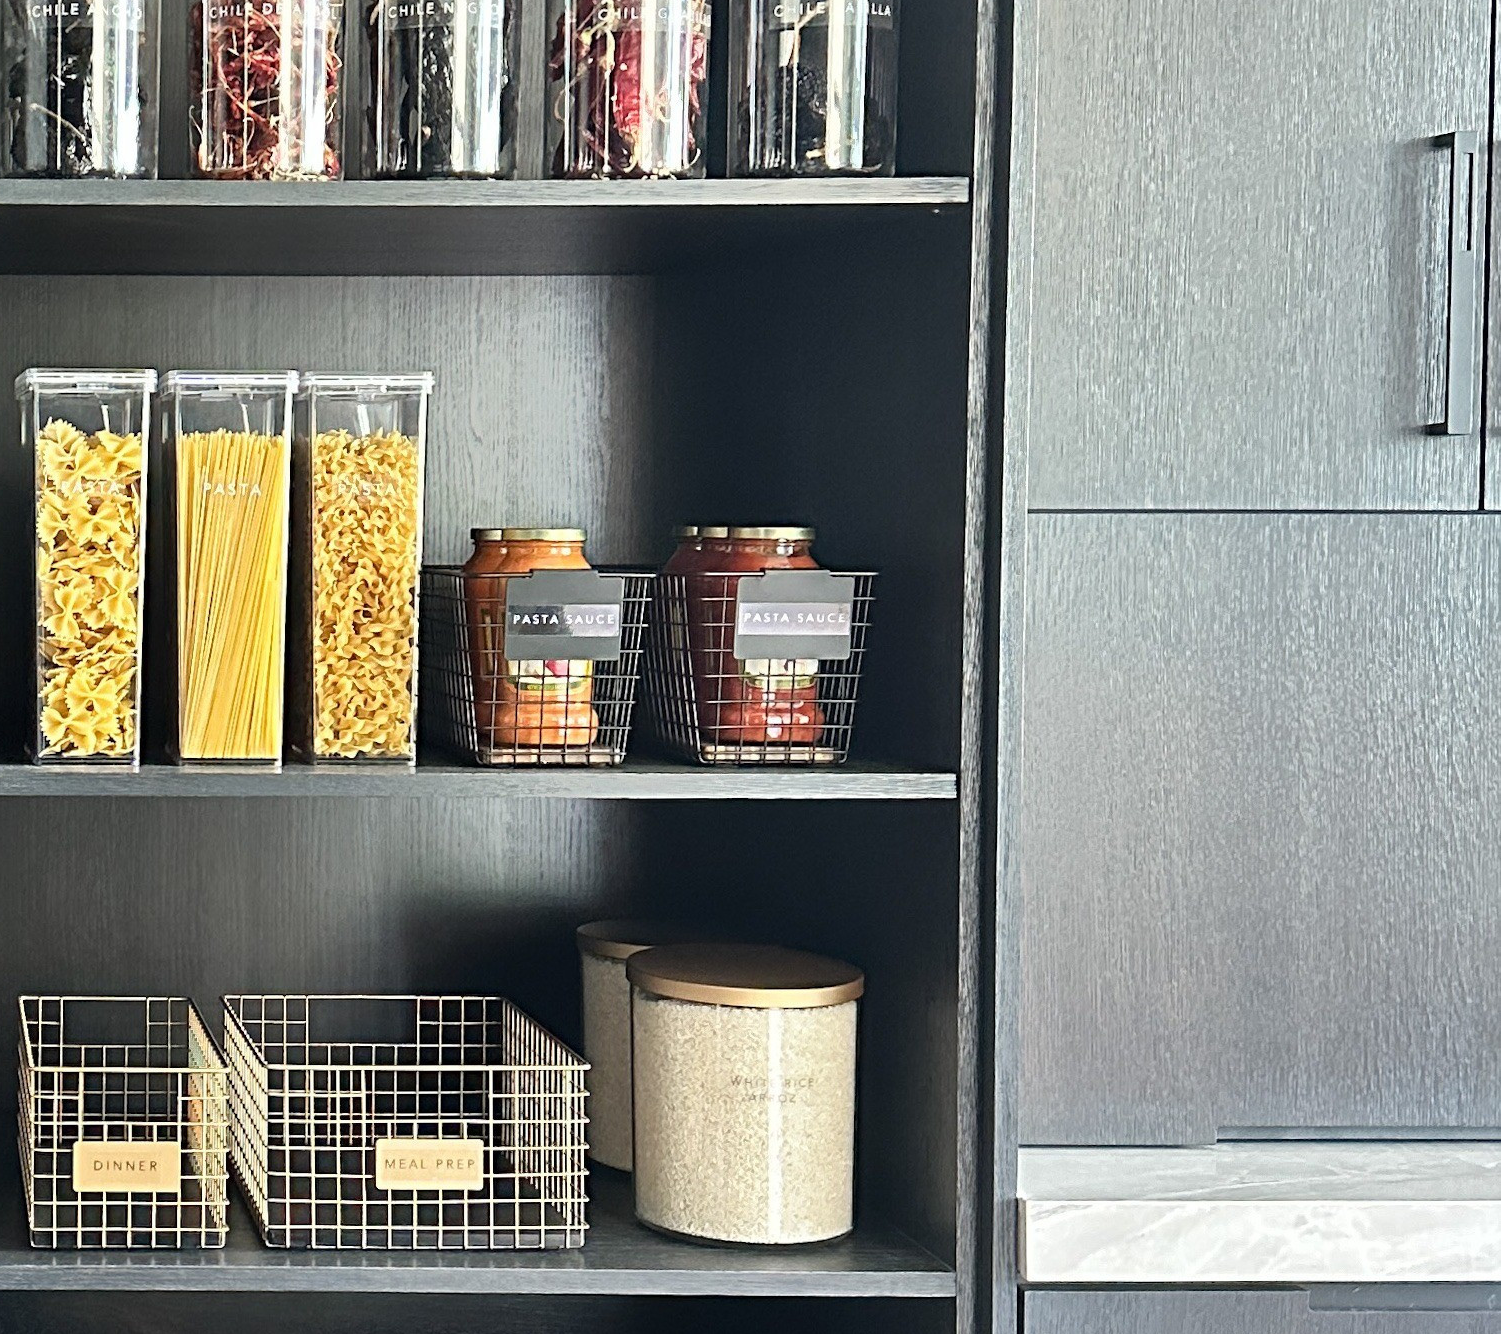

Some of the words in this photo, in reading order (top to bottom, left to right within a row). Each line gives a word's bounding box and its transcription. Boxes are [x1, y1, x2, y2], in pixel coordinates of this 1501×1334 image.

[31, 3, 80, 18] CHILE
[388, 2, 435, 19] CHILE
[202, 482, 263, 497] PASTA
[337, 481, 395, 497] PASTA
[512, 613, 559, 625] PASTA
[565, 613, 615, 625] SAUCE
[743, 612, 790, 624] PASTA
[797, 612, 846, 624] SAUCE
[92, 1159, 158, 1172] DINNER
[383, 1156, 430, 1171] MEAL
[436, 1156, 476, 1171] PREP
